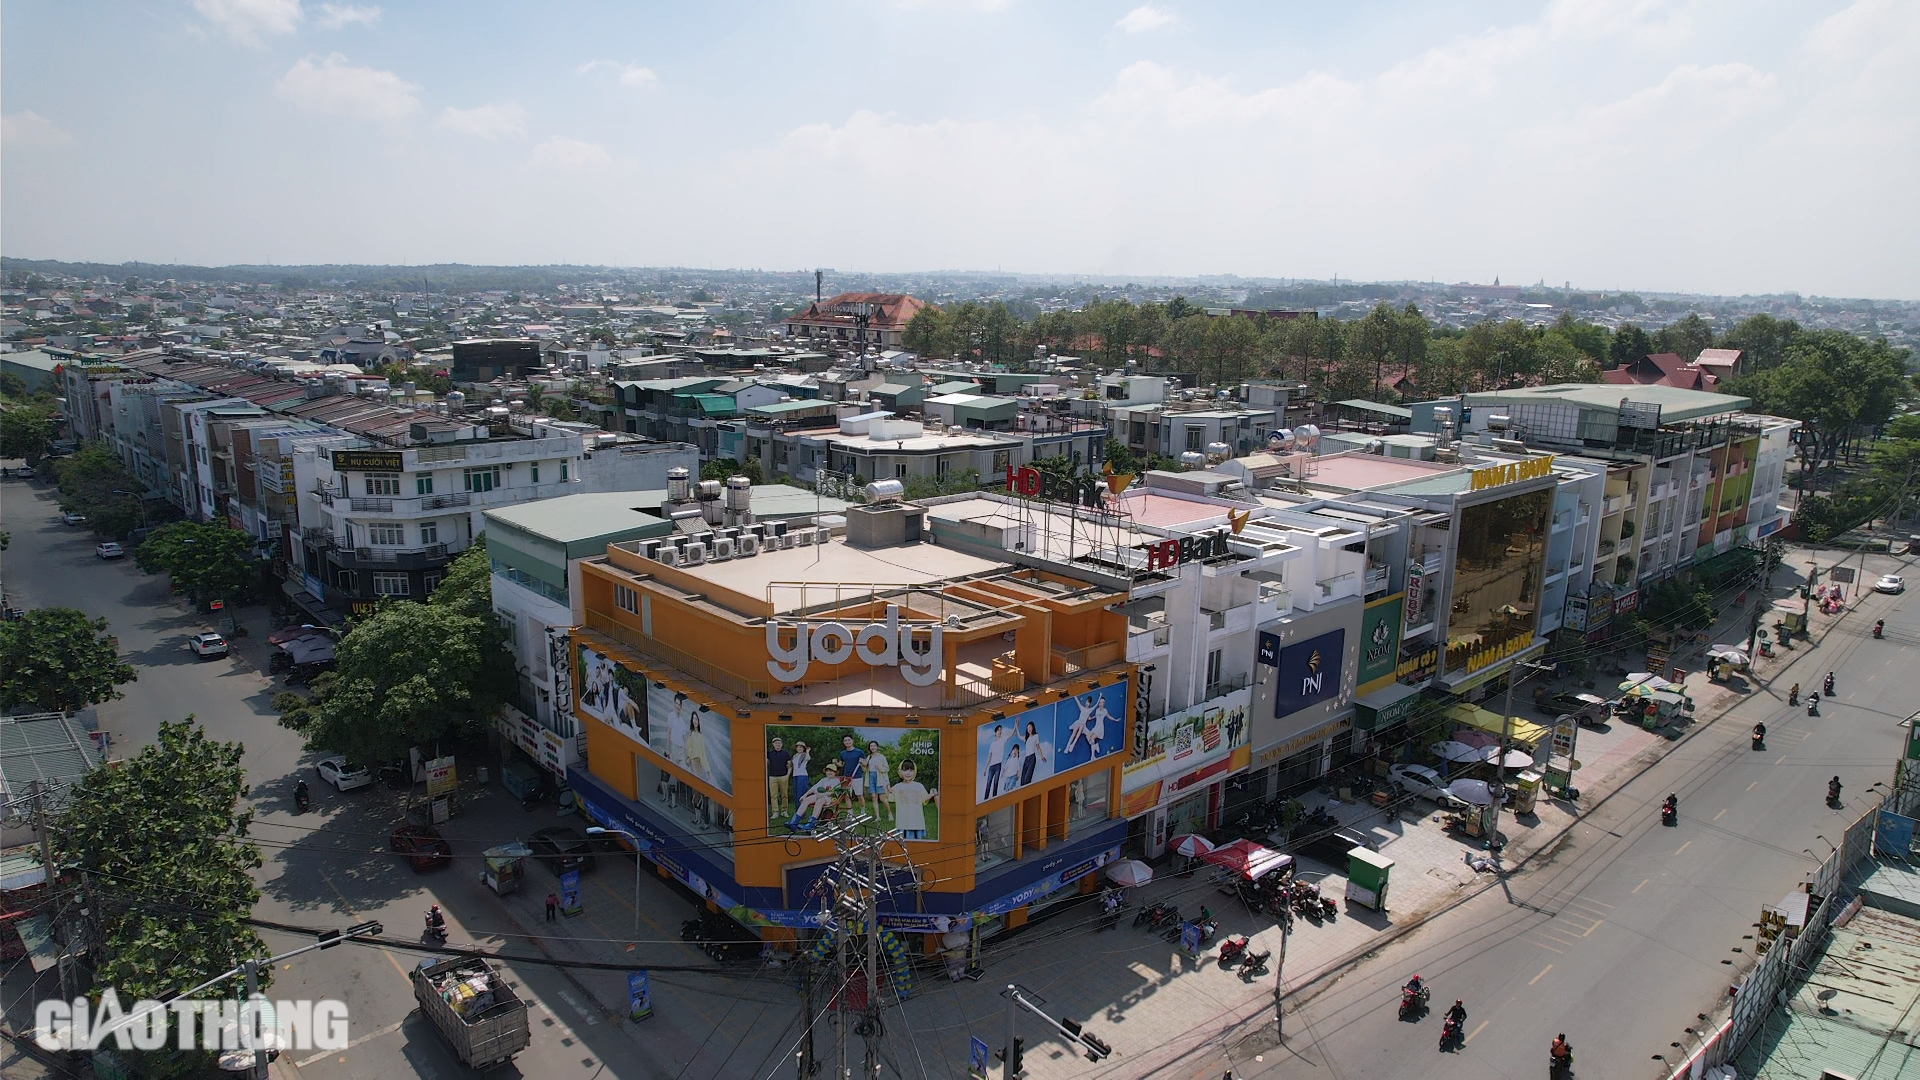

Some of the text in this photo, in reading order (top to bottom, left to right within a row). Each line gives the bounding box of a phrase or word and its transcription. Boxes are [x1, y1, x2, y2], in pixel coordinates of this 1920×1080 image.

[1007, 464, 1106, 509] HDBank
[1471, 465, 1505, 490] NAM
[1519, 454, 1555, 480] BANK
[1148, 529, 1231, 571] HDBank
[1407, 577, 1421, 620] RUBY
[766, 604, 943, 687] yody
[1261, 648, 1274, 659] PNJ
[1466, 646, 1496, 674] NAM
[1505, 630, 1535, 656] BANK
[553, 636, 571, 717] yody
[1302, 672, 1323, 696] PNJ
[1133, 672, 1149, 759] yody
[1012, 888, 1035, 905] YODY
